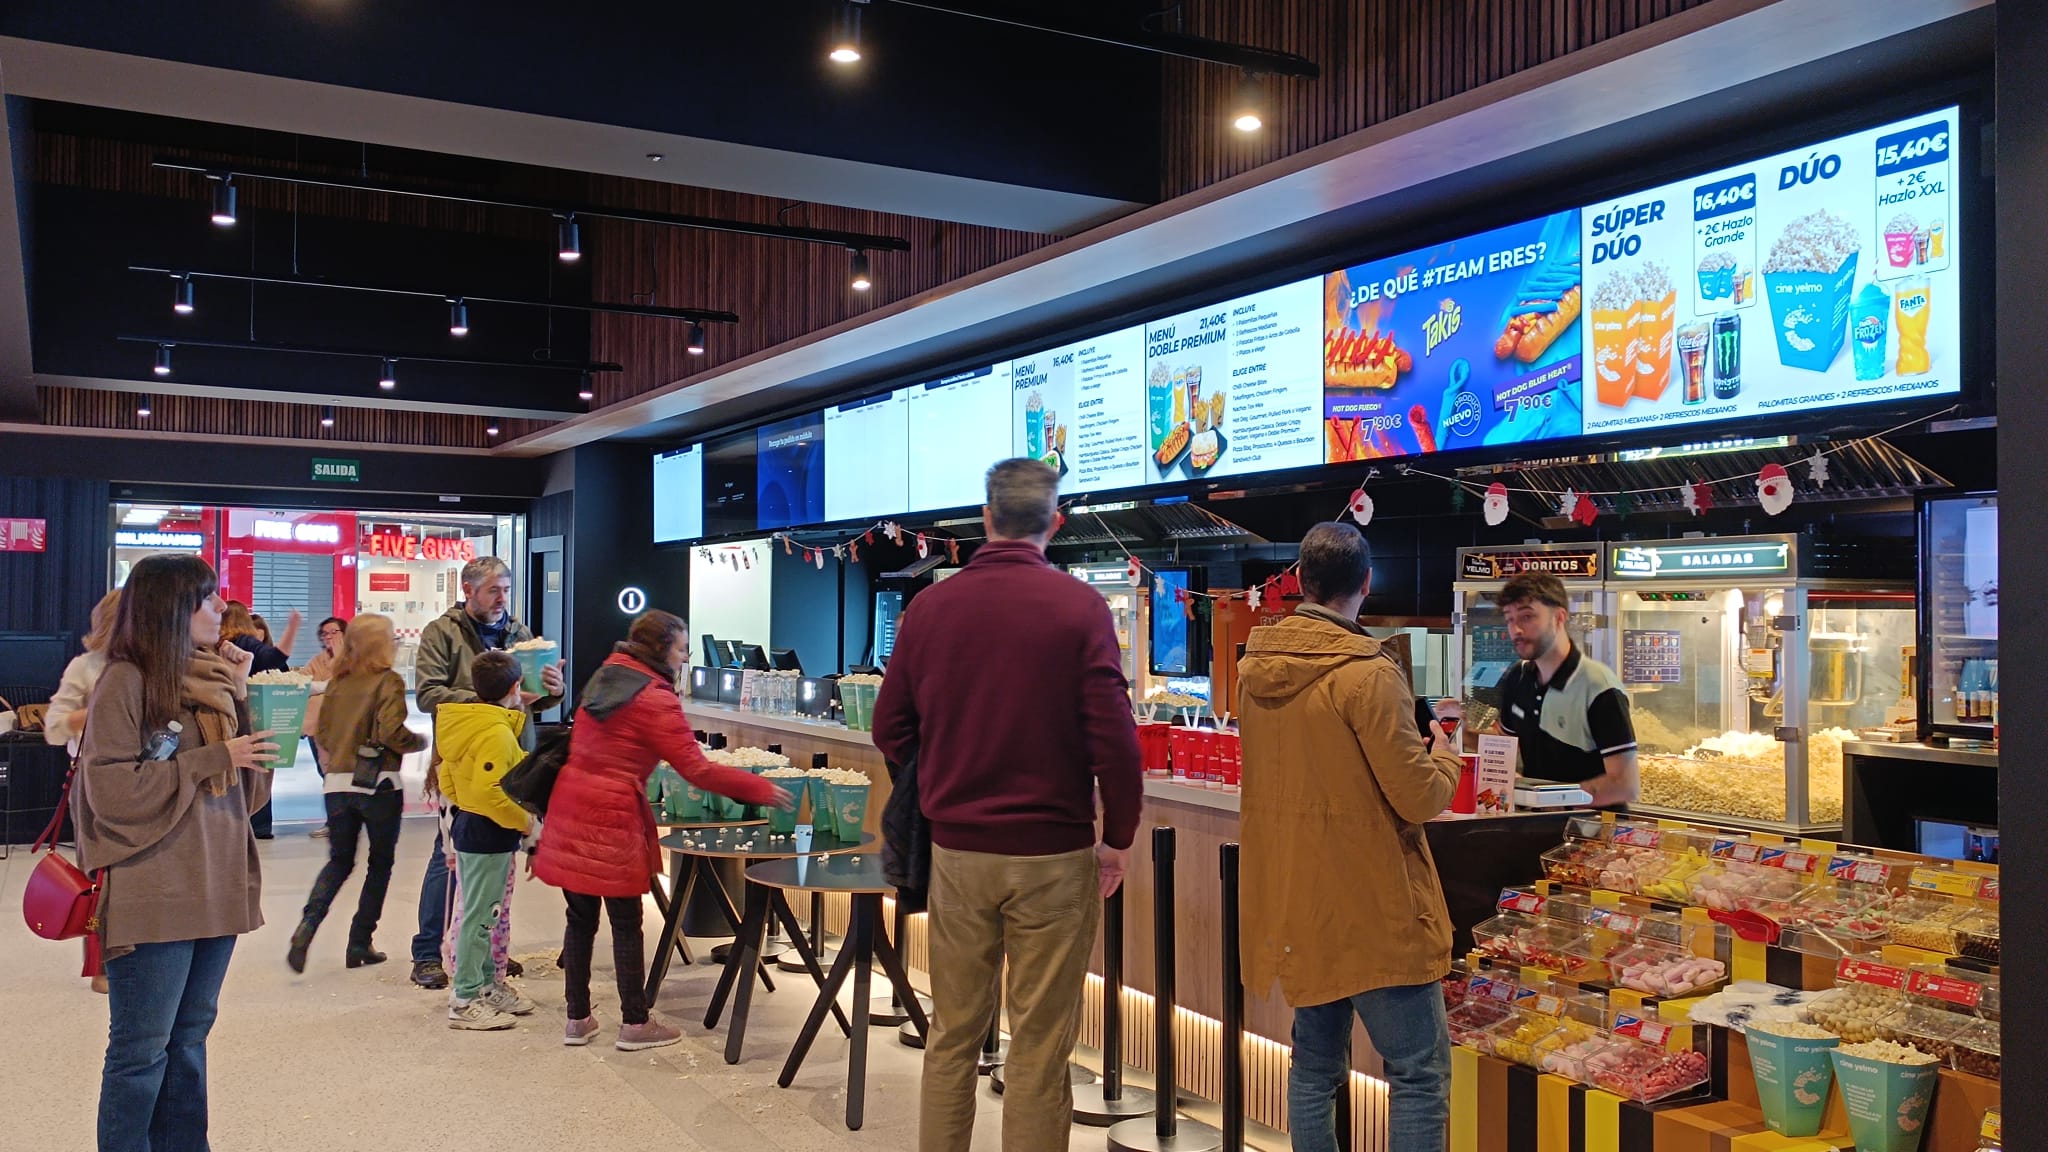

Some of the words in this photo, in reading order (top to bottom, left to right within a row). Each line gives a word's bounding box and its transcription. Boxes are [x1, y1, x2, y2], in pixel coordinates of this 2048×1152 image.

[1877, 132, 1949, 168] 15,40€
[1778, 152, 1842, 191] DÚO
[1907, 171, 1926, 186] 2€
[1695, 182, 1755, 212] 16,40€
[1878, 189, 1916, 207] Hazlo
[1918, 181, 1946, 198] XXL
[1591, 199, 1666, 237] SÚPER
[1705, 222, 1720, 236] 2€
[1722, 216, 1754, 232] Hazlo
[1591, 232, 1642, 265] DÚO
[1704, 230, 1745, 248] Grande
[1350, 282, 1380, 309] ¿DE
[1384, 272, 1419, 300] QUÉ
[1422, 256, 1485, 288] #TEAM
[1489, 241, 1548, 273] ERES?
[1776, 284, 1793, 293] cine
[1795, 283, 1823, 295] yelmo
[1233, 304, 1256, 316] INCLUYE
[1199, 313, 1227, 330] 21,40€
[1422, 300, 1463, 357] Takis
[1854, 321, 1887, 341] FROZEN
[1149, 323, 1176, 344] MENÚ
[1149, 340, 1179, 358] DOBLE
[1180, 328, 1226, 351] PREMIUM
[1015, 360, 1036, 378] MENÚ
[1233, 367, 1248, 377] ELIGE
[1248, 363, 1267, 374] ENTRE
[1015, 373, 1048, 391] PREMIUM
[1495, 389, 1511, 403] HOT
[1512, 383, 1528, 397] DOG
[1528, 376, 1547, 391] BLUE
[1758, 397, 1798, 409] PALOMITAS
[1798, 393, 1835, 405] GRANDES
[1841, 391, 1847, 400] 2
[1846, 385, 1893, 398] REFRESCOS
[1893, 379, 1940, 393] MEDIANOS
[1332, 404, 1344, 412] HOT
[1345, 404, 1358, 412] DOG
[1455, 392, 1481, 422] PRODUCTO
[1592, 418, 1624, 429] PALOMITAS
[1664, 409, 1701, 420] REFRESCOS
[1701, 404, 1737, 416] MEDIANOS
[1443, 408, 1472, 429] NUEVO
[314, 463, 357, 477] SALIDA
[369, 533, 418, 560] FIVE
[422, 535, 476, 561] GUYS
[1466, 565, 1491, 574] YELMO
[1522, 560, 1579, 571] DORITOS
[1681, 553, 1755, 566] SALADAS
[1260, 615, 1284, 626] FANT
[1794, 1045, 1811, 1053] cine
[1840, 1059, 1853, 1069] cine
[1854, 1063, 1879, 1074] yelmo
[1900, 1071, 1917, 1079] cine
